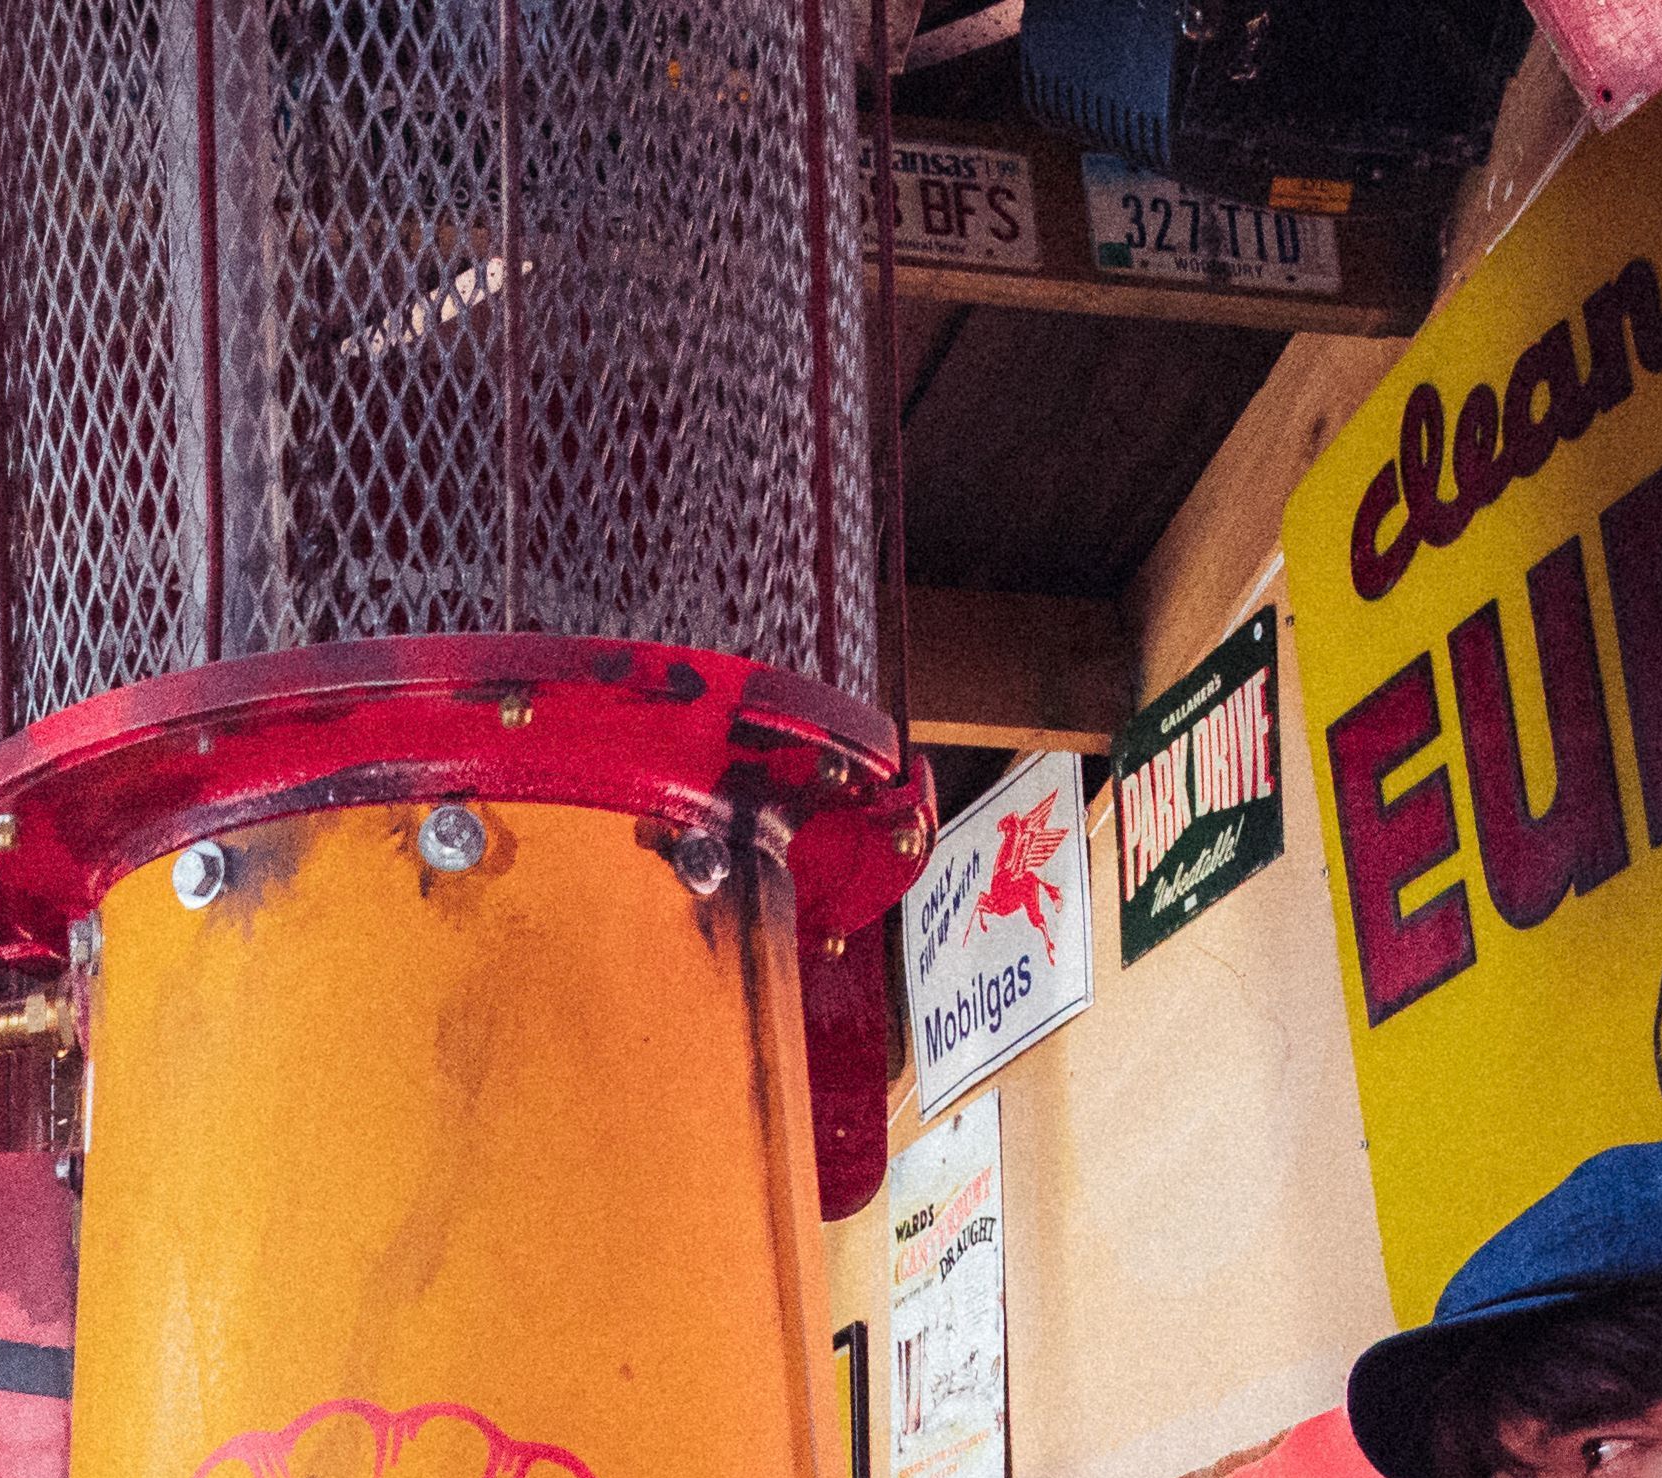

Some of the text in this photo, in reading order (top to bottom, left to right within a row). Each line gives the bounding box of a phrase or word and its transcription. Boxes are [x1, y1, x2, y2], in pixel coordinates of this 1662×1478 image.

[1123, 194, 1198, 254] 327
[1122, 666, 1275, 902] PARK DRIVE
[920, 857, 956, 935] ONLY
[951, 850, 981, 920] with
[925, 954, 1033, 1067] Mobilgas
[938, 1215, 996, 1284] DRAUGHT
